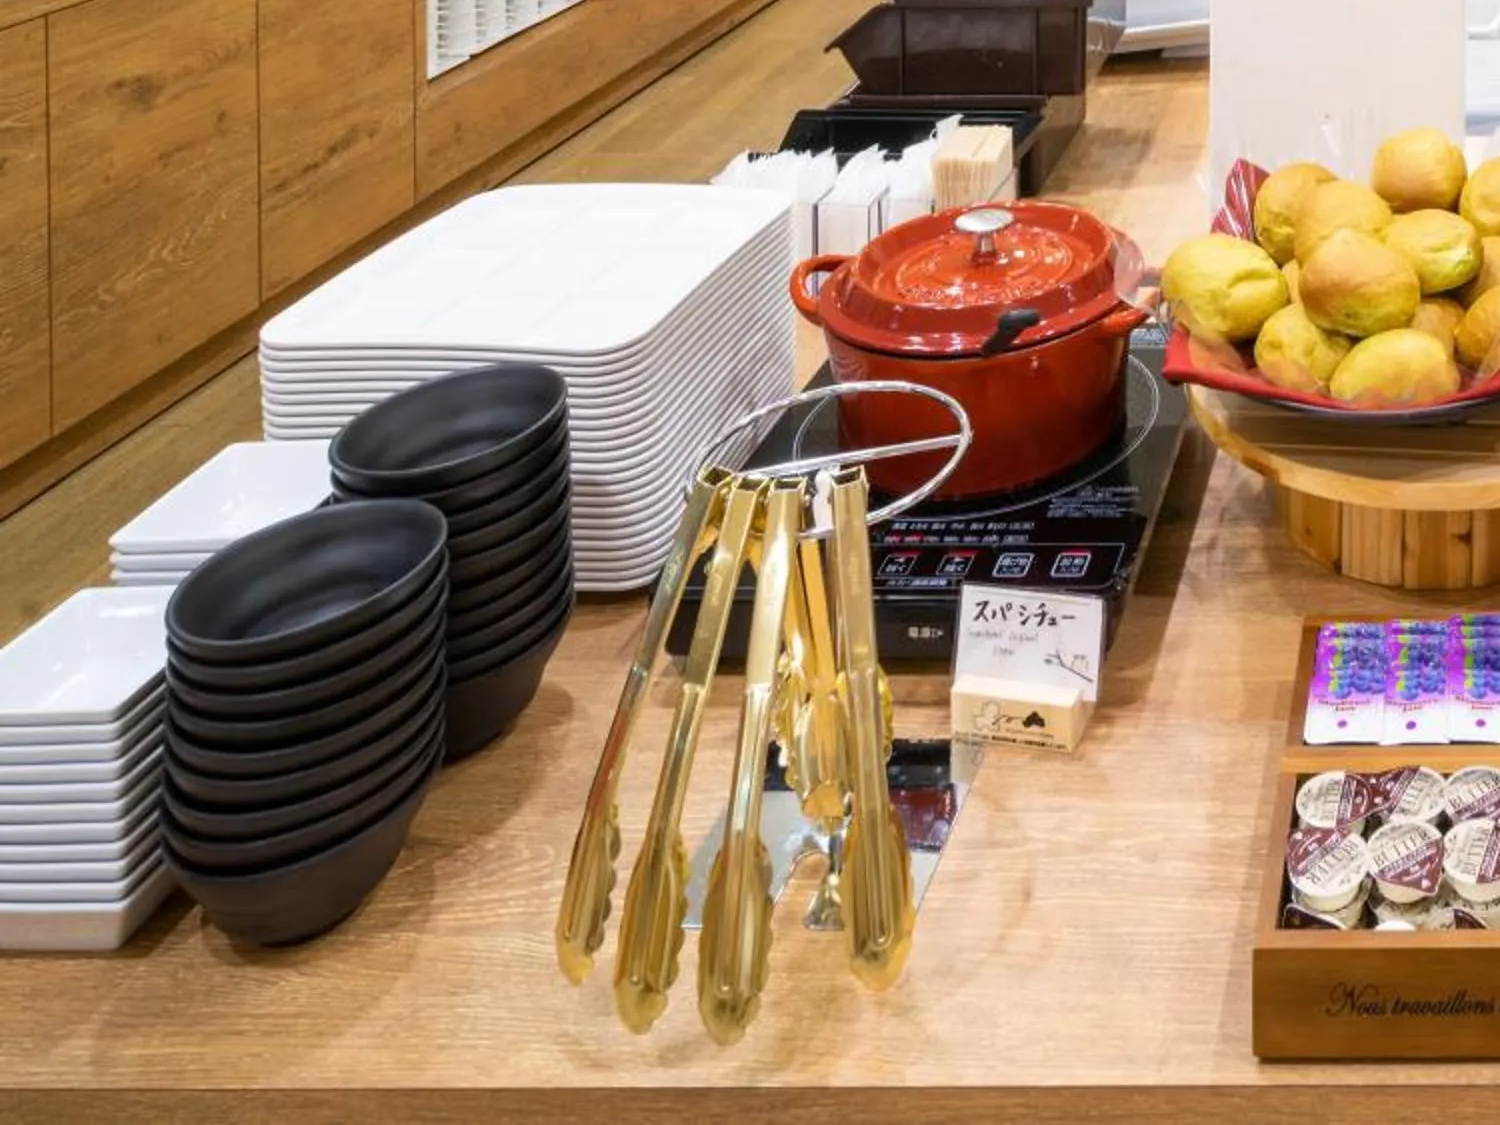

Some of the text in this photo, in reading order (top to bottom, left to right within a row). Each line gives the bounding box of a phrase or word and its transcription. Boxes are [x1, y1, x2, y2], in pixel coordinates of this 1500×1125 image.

[1373, 828, 1430, 868] BUTTER
[1326, 981, 1386, 1016] Nous
[1391, 989, 1494, 1016] travaillons
